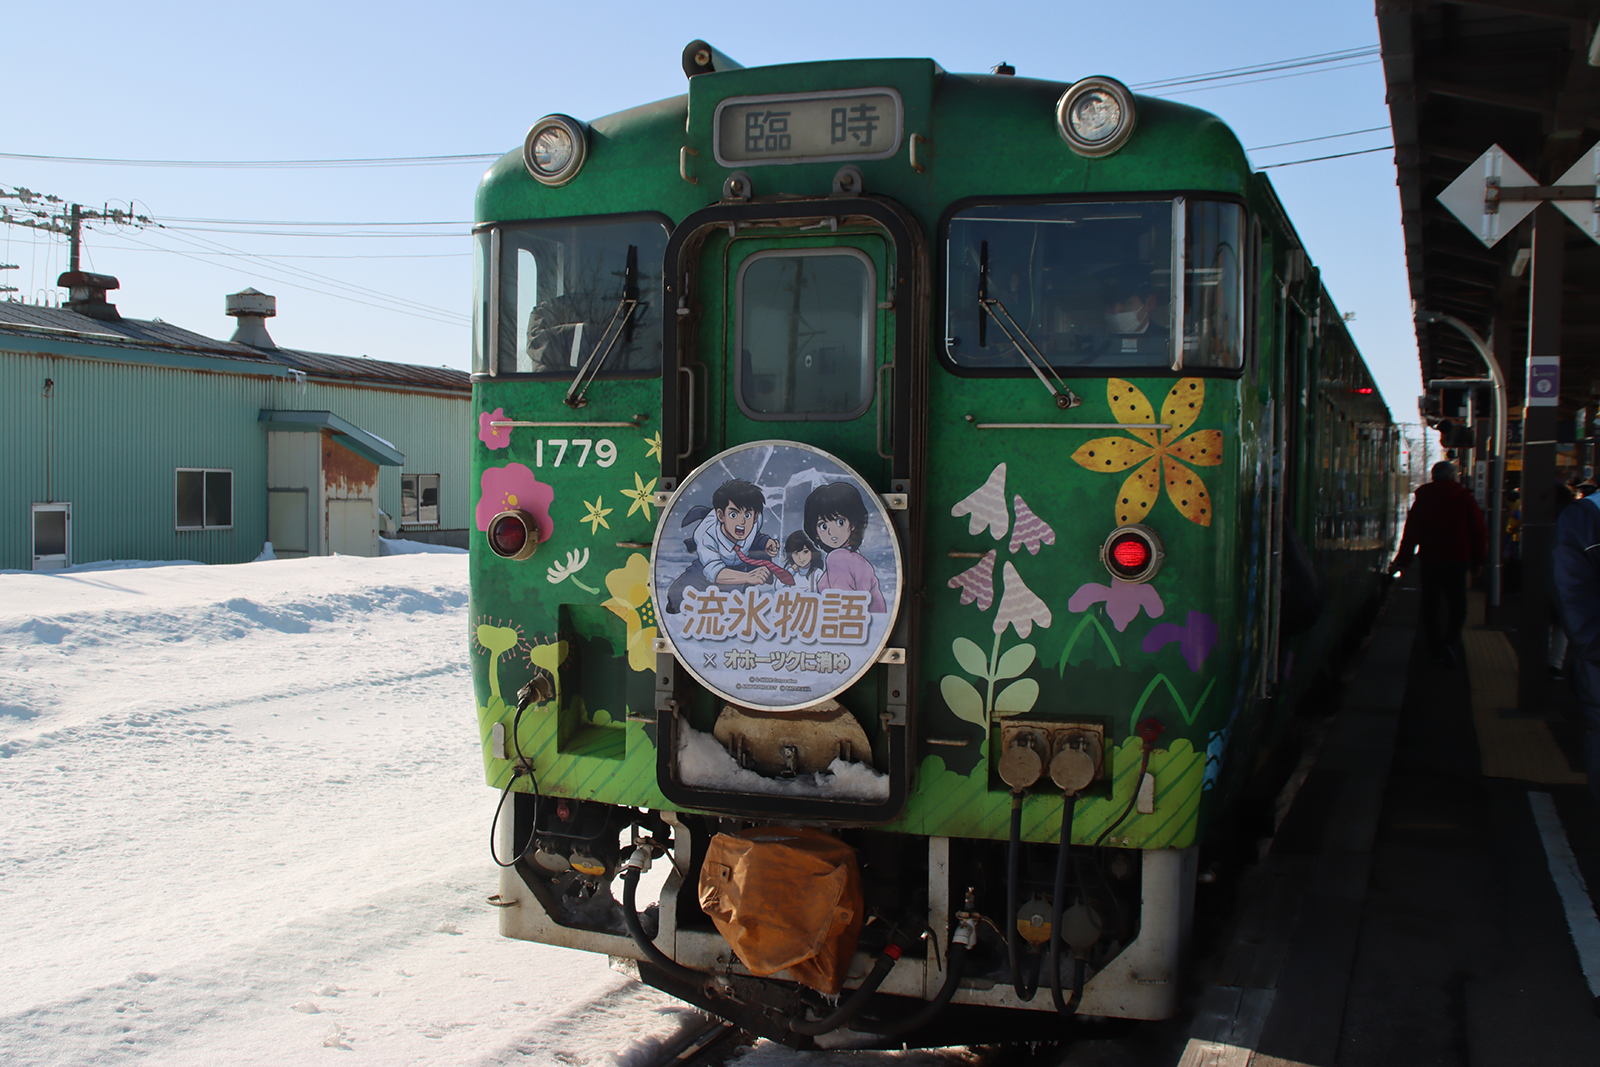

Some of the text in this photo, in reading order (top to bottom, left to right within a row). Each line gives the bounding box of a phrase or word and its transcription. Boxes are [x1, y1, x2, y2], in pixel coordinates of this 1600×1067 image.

[536, 438, 618, 468] 1779
[682, 589, 867, 640] 流氷物語
[724, 649, 851, 674] オホーツクに消ゆ
